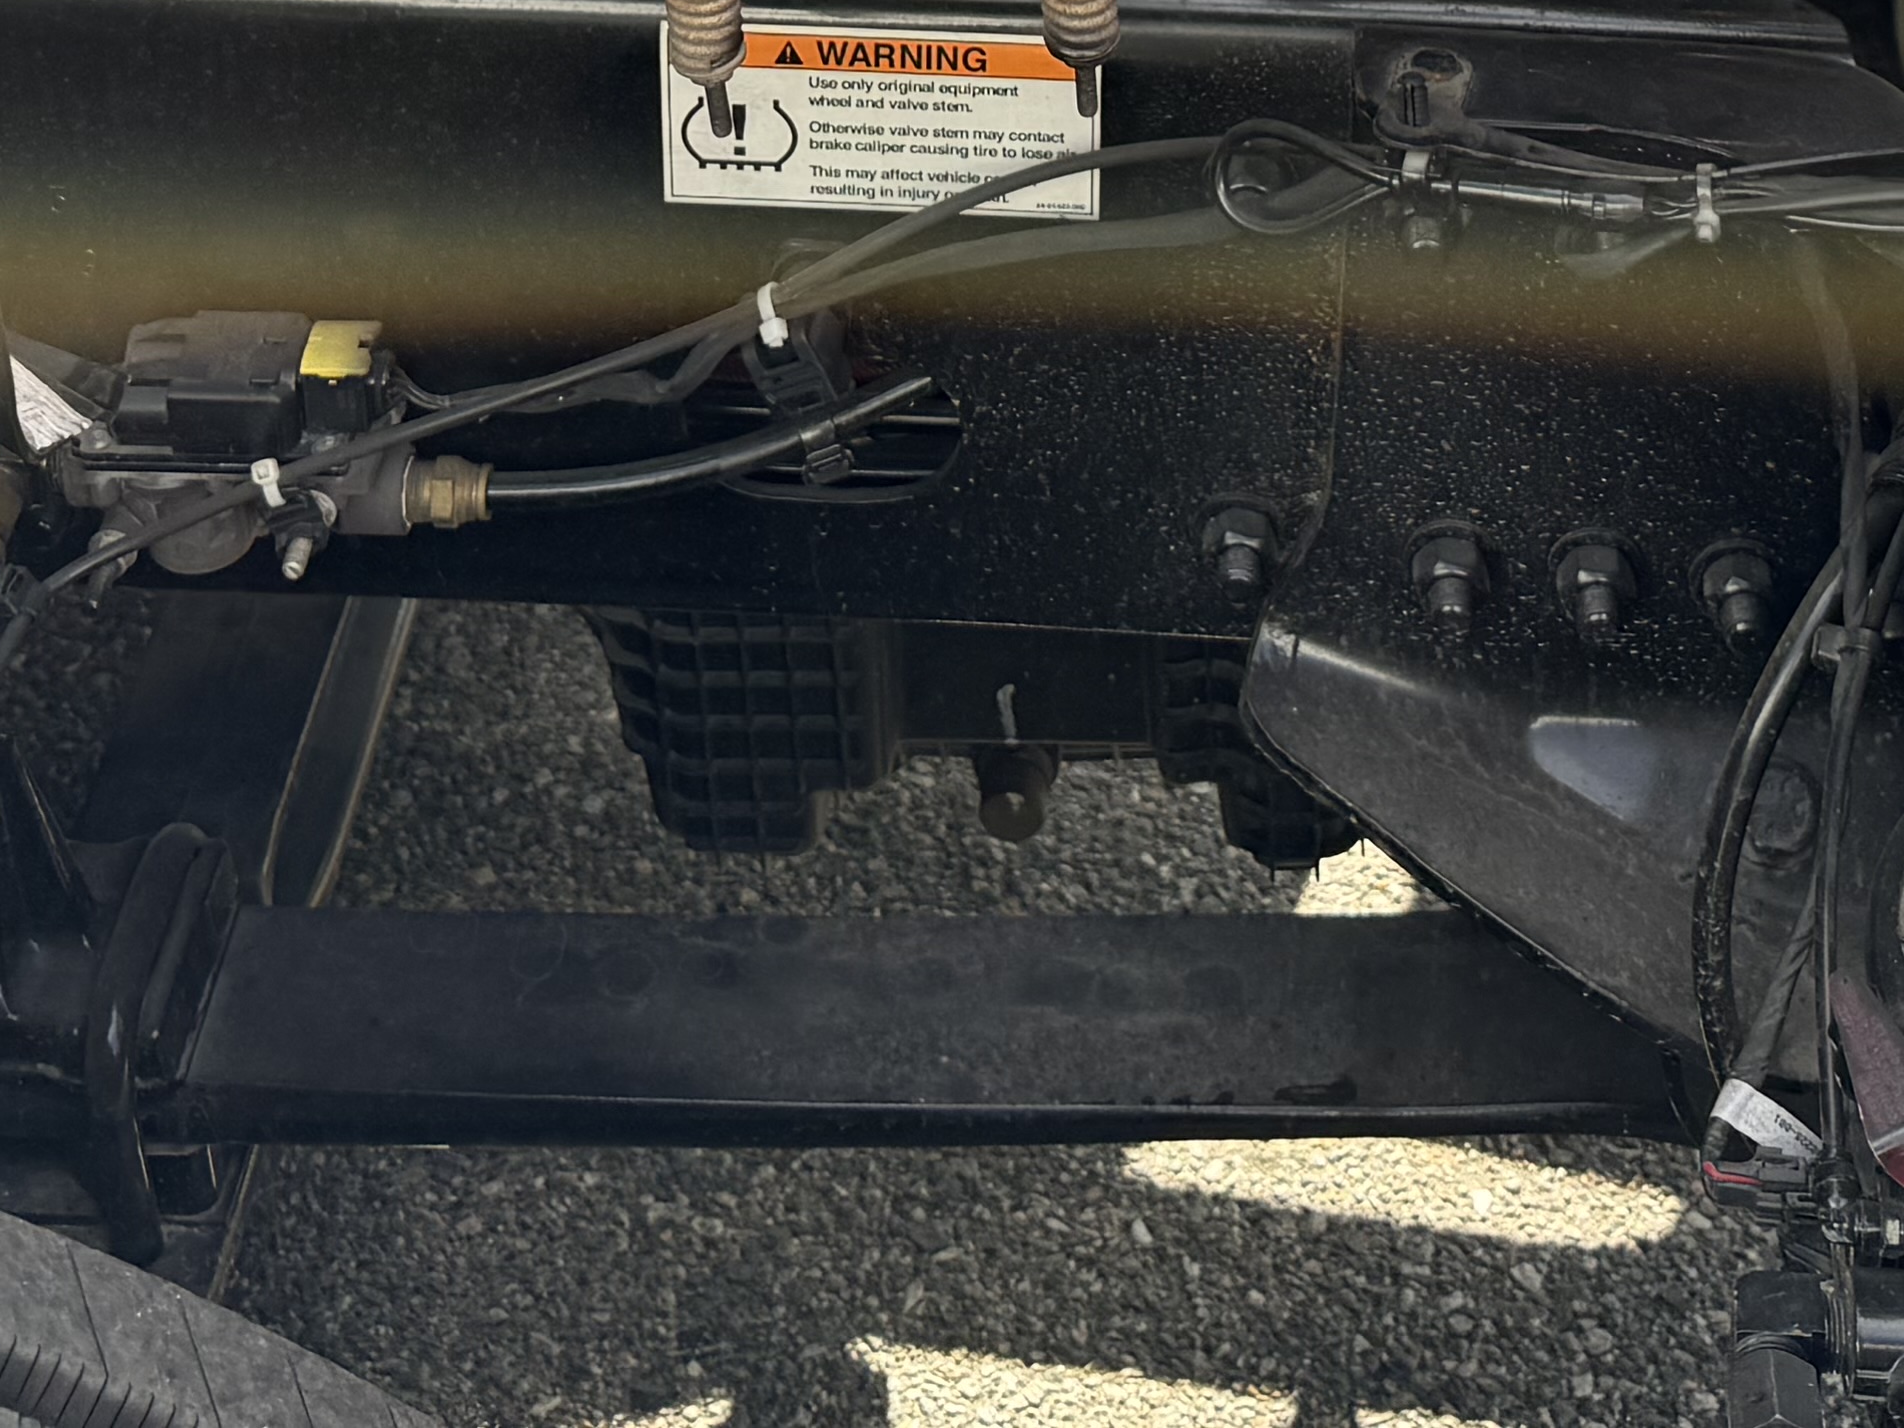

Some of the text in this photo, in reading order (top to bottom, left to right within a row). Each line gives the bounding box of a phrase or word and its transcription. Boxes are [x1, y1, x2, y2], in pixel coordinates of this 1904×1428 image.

[816, 41, 988, 73] WARNING
[809, 76, 1019, 100] Use only original equipment
[809, 96, 973, 113] wheel and valve stem.
[809, 121, 1065, 145] Otherwise valve stem may contact
[809, 138, 852, 152] brake
[855, 139, 906, 156] caliper
[909, 143, 969, 160] causing
[973, 143, 997, 157] tire
[1001, 145, 1016, 158] to
[1021, 145, 1053, 160] lose
[809, 165, 841, 178] This
[845, 168, 877, 183] may
[881, 168, 924, 182] affect
[928, 171, 980, 184] vehicle
[811, 182, 875, 200] resulting
[879, 186, 894, 198] in
[897, 185, 940, 203] injury
